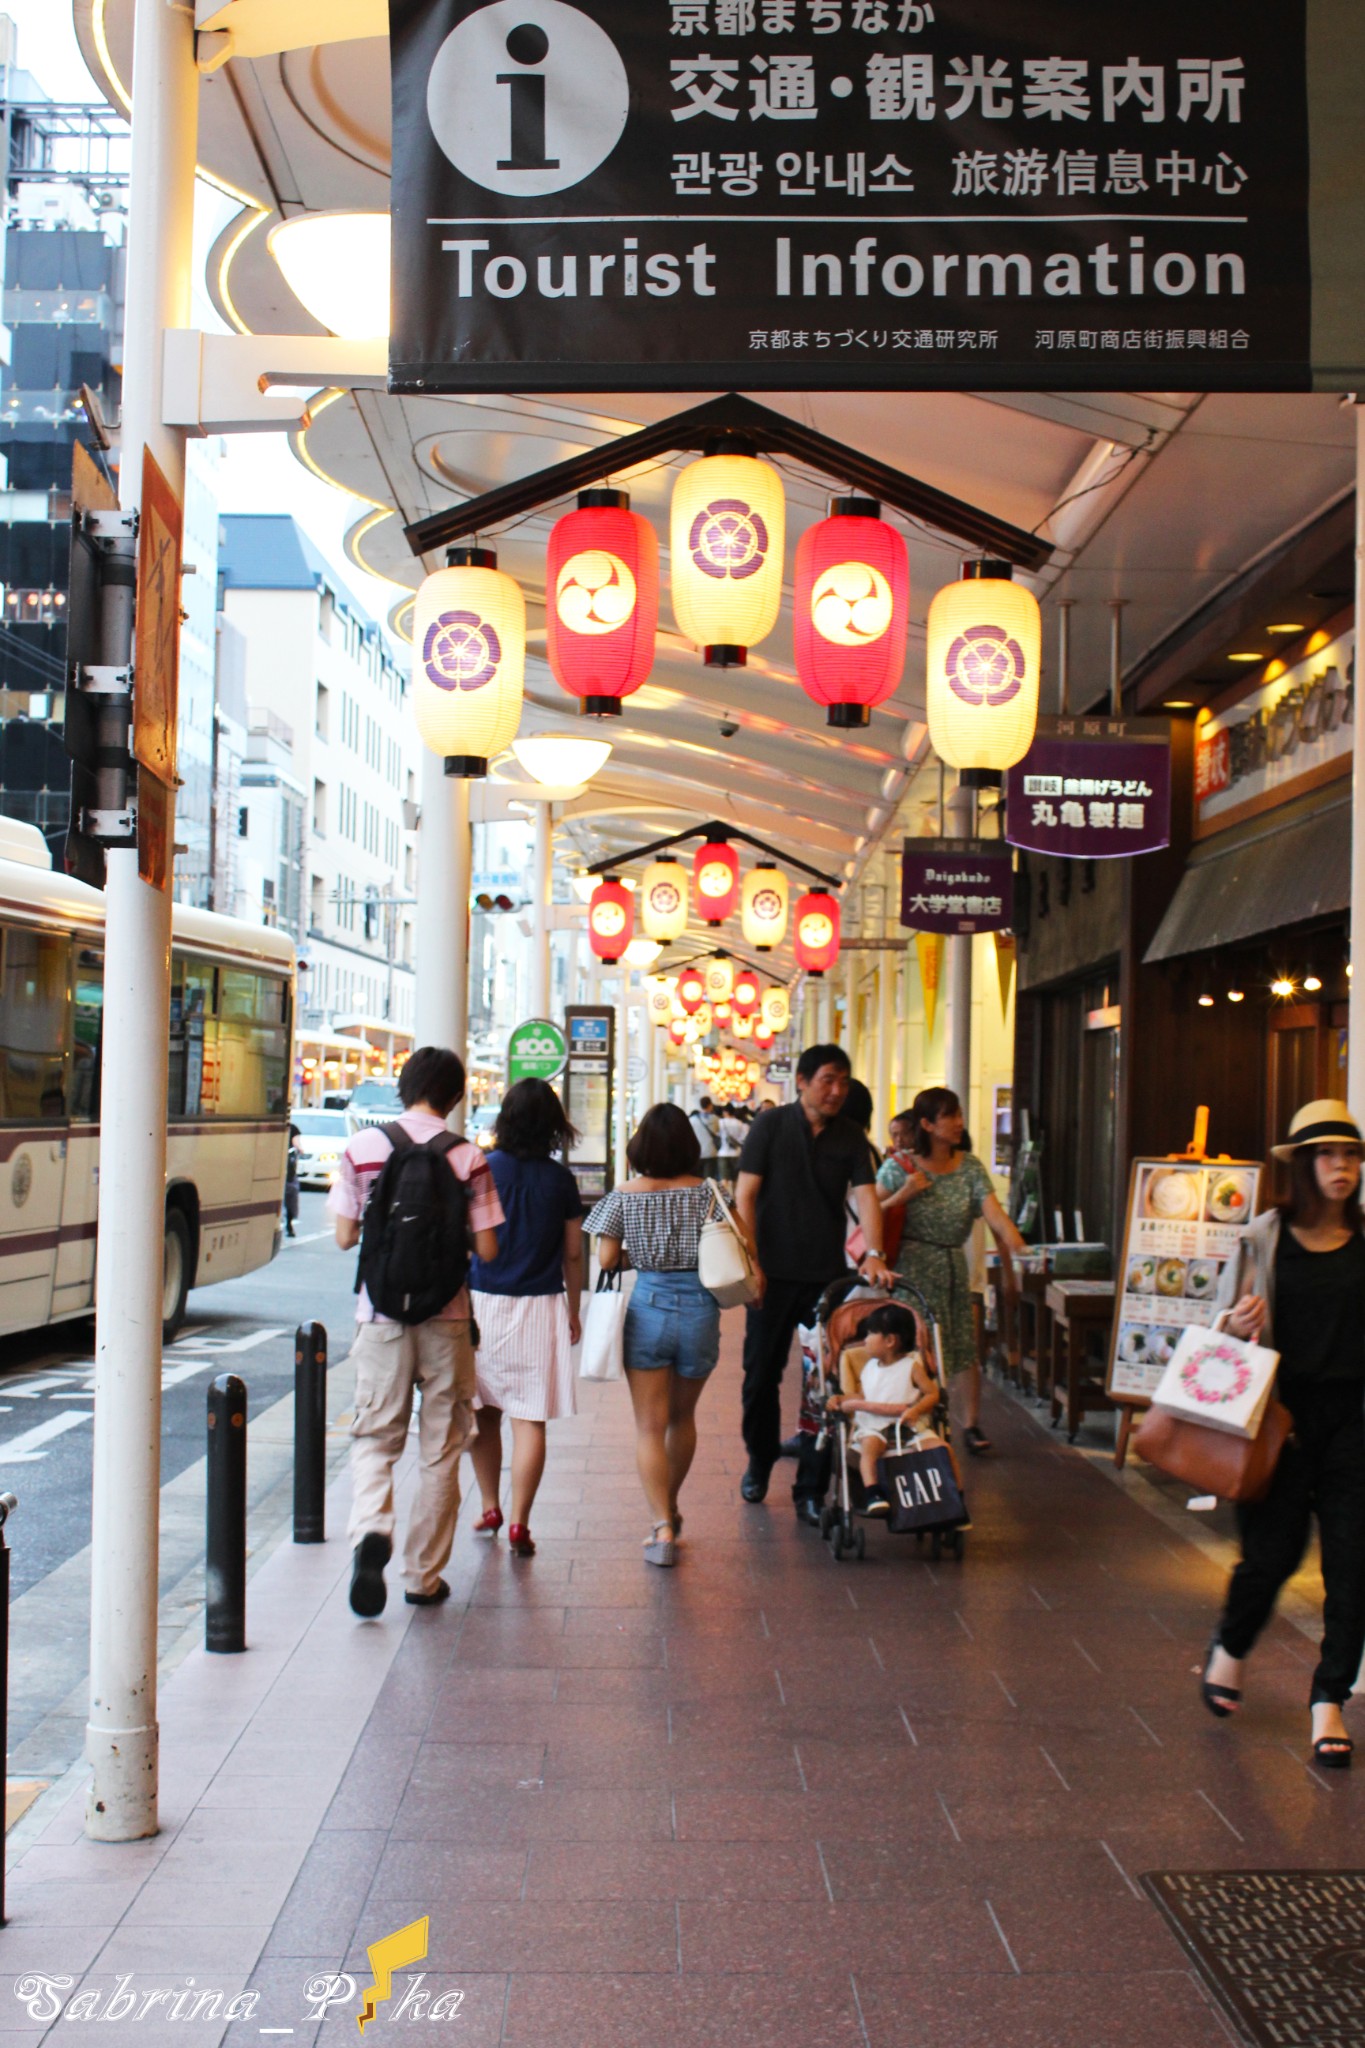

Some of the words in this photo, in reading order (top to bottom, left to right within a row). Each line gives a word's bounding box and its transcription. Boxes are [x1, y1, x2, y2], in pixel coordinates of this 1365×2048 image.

[669, 0, 934, 36] 京都まちなか
[670, 53, 1244, 122] 交通・観光案内所
[671, 152, 762, 196] 관광
[776, 152, 914, 196] 안내소
[952, 148, 1248, 196] 旅游信息中心
[442, 238, 715, 298] Tourist
[777, 237, 1244, 297] Information
[749, 329, 998, 349] 京都まちづくり交通研究所
[1035, 329, 1249, 349] 河原町商店街振興組合
[1031, 800, 1145, 829] 丸亀製麺
[909, 893, 1003, 916] 大学堂書店
[895, 1467, 942, 1509] GAP
